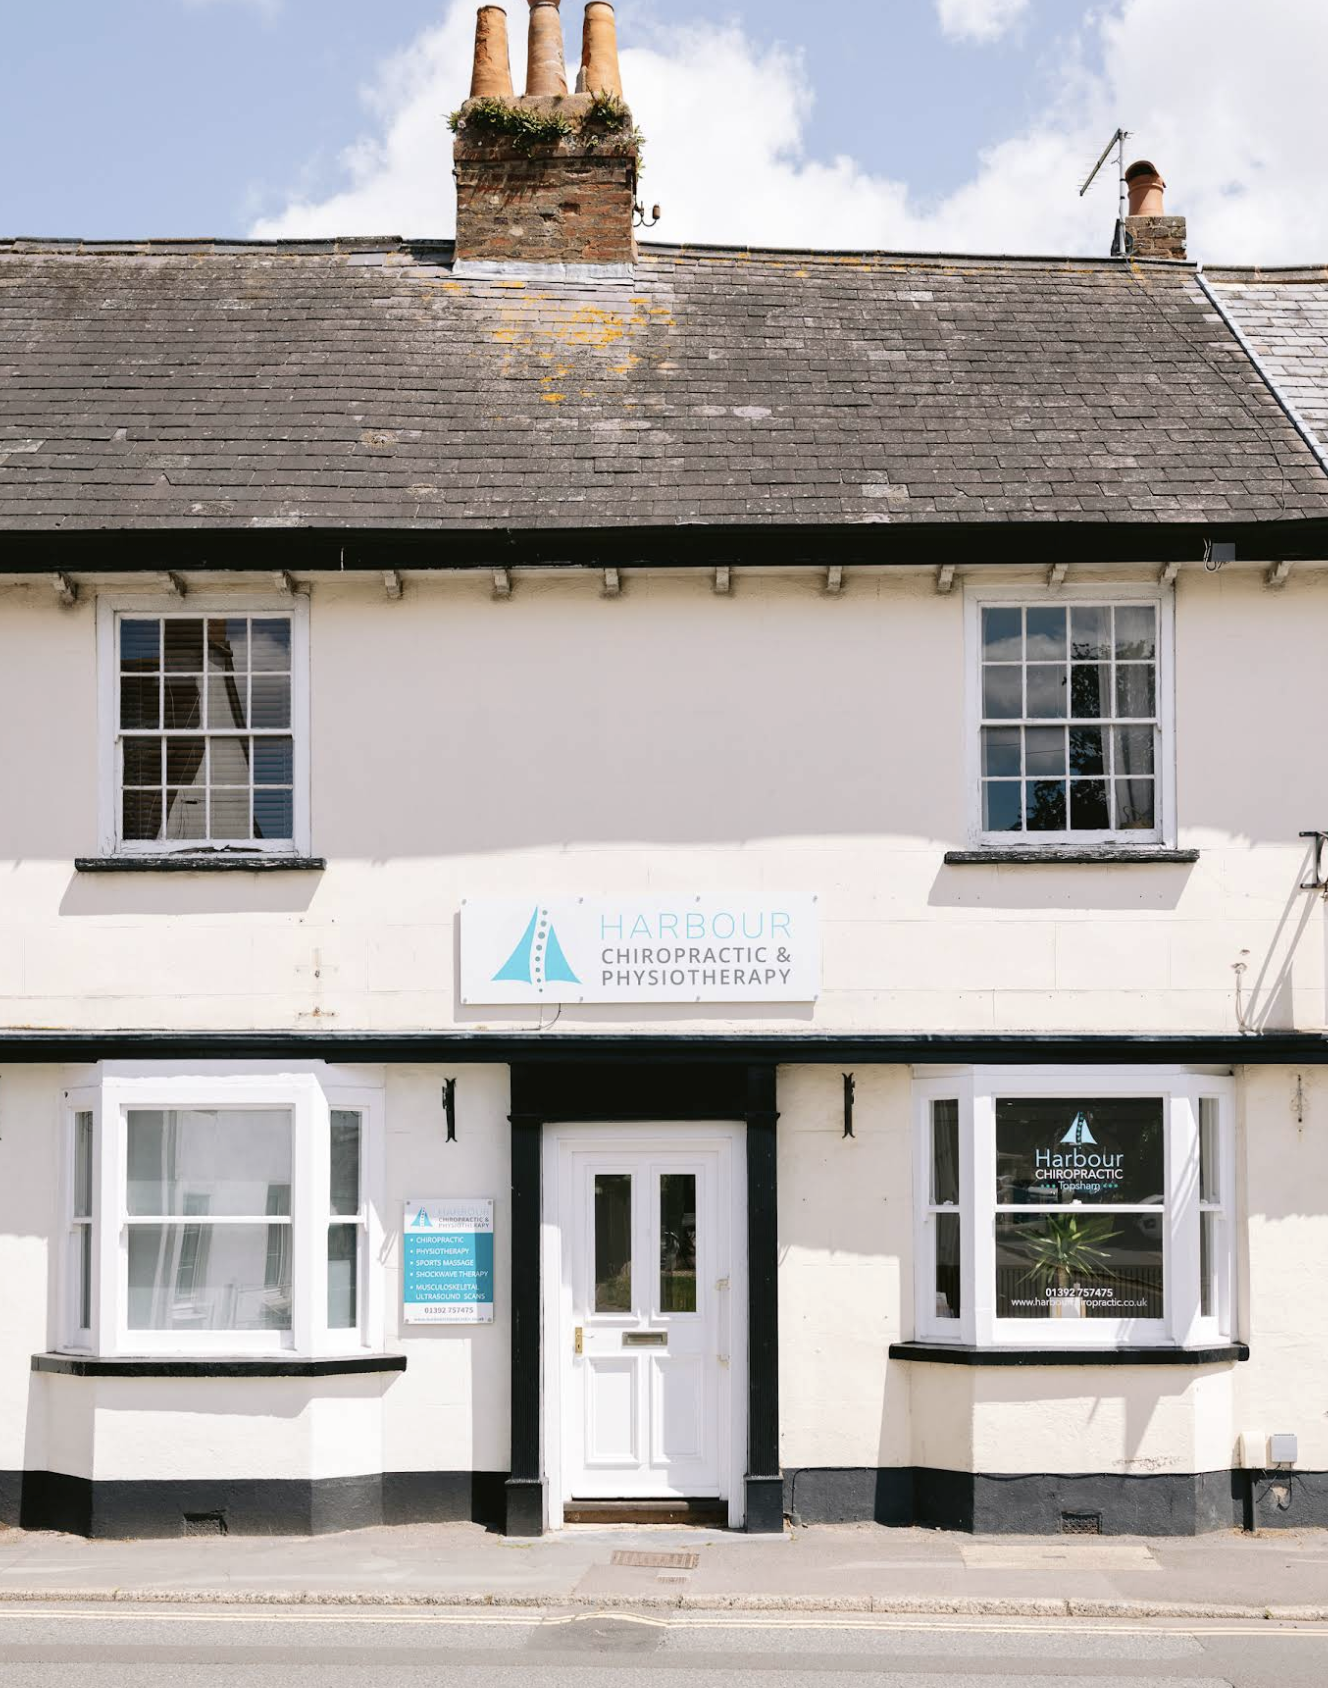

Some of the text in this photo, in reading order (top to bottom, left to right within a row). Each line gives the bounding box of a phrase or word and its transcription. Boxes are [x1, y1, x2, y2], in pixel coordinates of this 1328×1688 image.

[600, 912, 792, 940] HARBOUR
[601, 946, 791, 965] CHIROPRACTIC &
[601, 967, 792, 986] PHYSIOTHERAPY
[1035, 1147, 1124, 1168] Harbour
[1035, 1169, 1124, 1180] CHIROPRACTIC
[1045, 1287, 1113, 1297] 01392 757475
[424, 1306, 447, 1314] 01392
